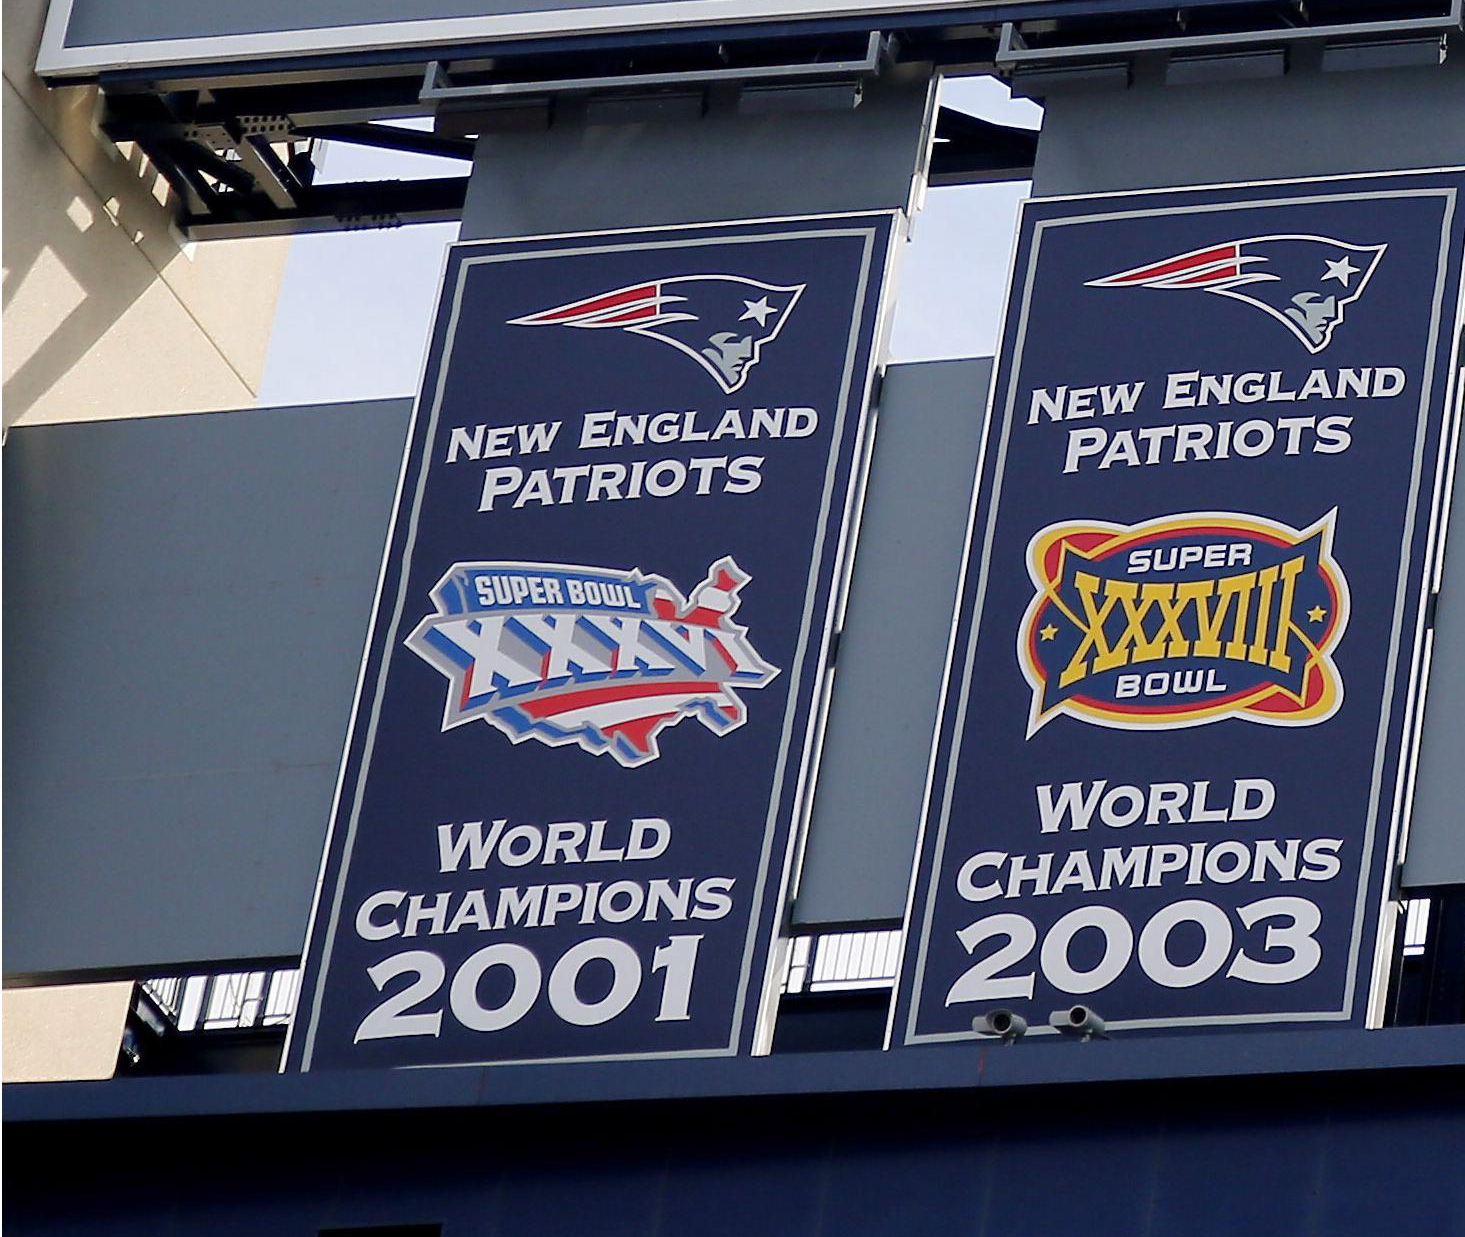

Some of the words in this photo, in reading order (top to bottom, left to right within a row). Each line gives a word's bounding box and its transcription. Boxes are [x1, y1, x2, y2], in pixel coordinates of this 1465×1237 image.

[1026, 381, 1146, 425] NEW
[1162, 367, 1406, 409] ENGLAND
[445, 421, 563, 464] NEW
[578, 407, 818, 449] ENGLAND
[1062, 415, 1354, 474] PATRIOTS
[477, 455, 765, 512] PATRIOTS
[1127, 543, 1253, 573] SUPER
[474, 575, 564, 606] SUPER
[570, 578, 642, 609] BOWL
[1058, 555, 1305, 688] XXXVIII
[425, 613, 764, 704] XXXVI
[1115, 669, 1227, 698] BOWL
[1036, 778, 1276, 834] WORLD
[437, 818, 671, 873] WORLD
[956, 838, 1344, 902] CHAMPIONS
[355, 877, 737, 941] CHAMPIONS
[944, 896, 1322, 1008] 2003
[353, 934, 705, 1045] 2001
